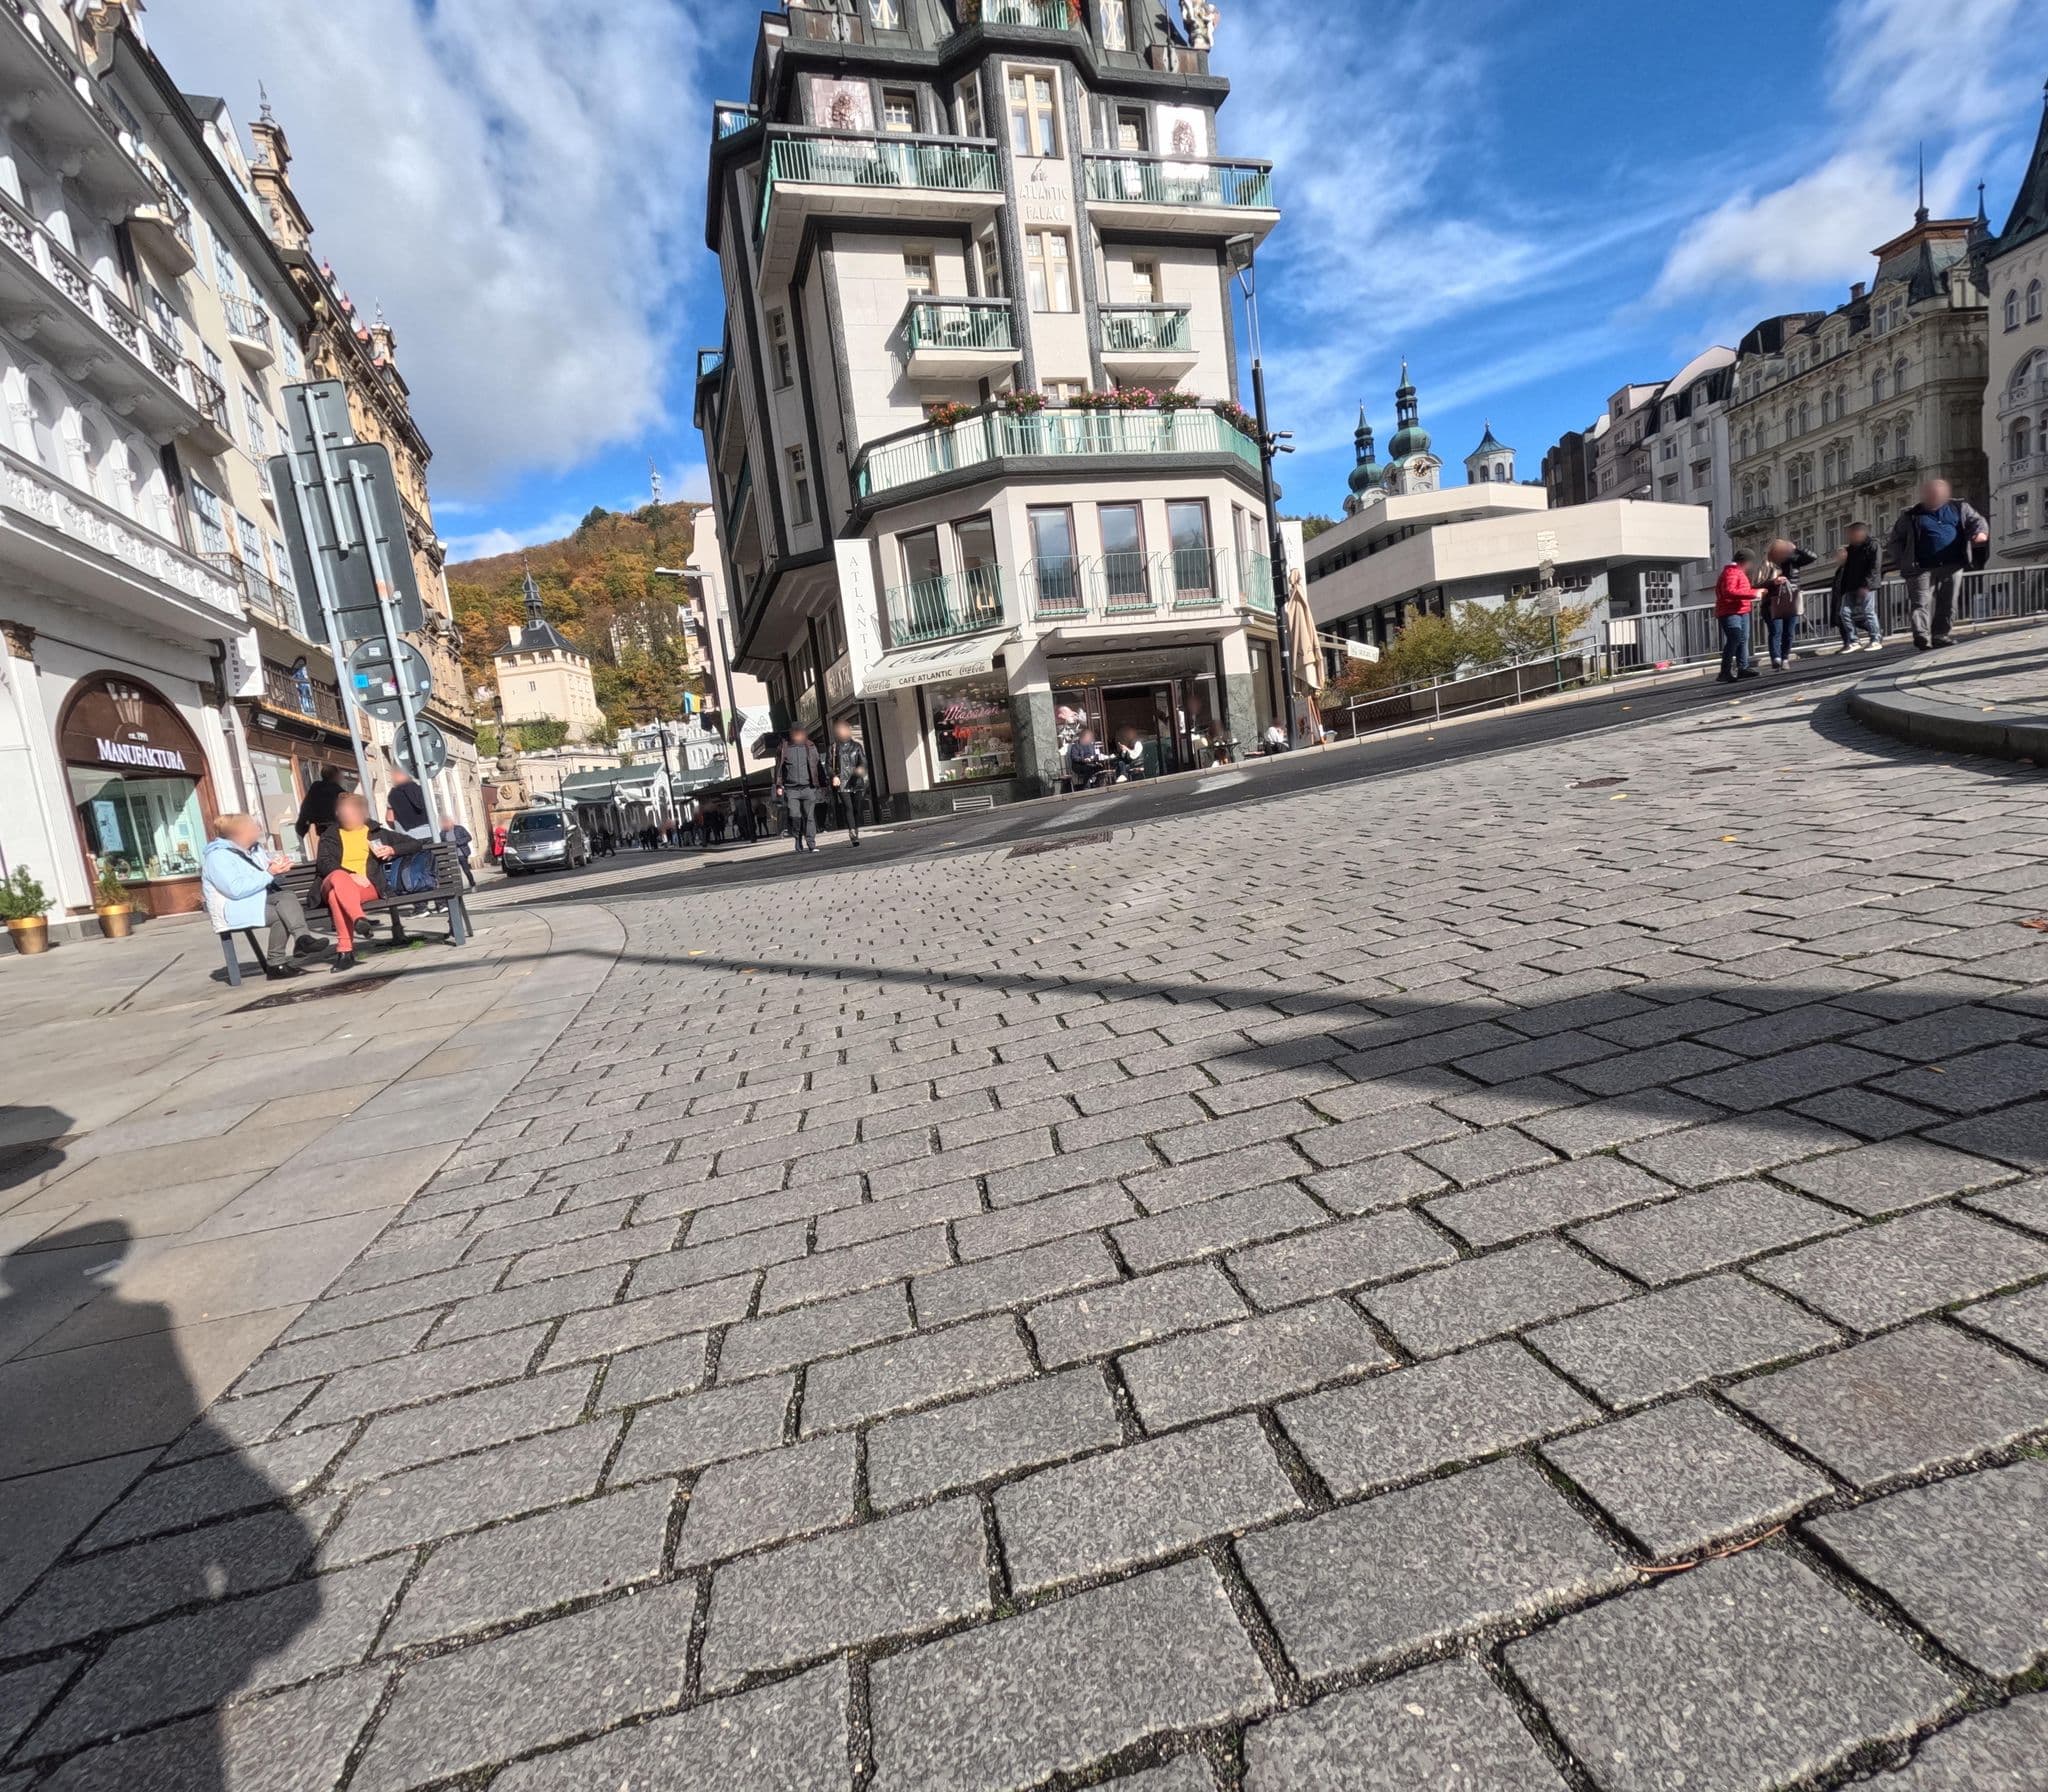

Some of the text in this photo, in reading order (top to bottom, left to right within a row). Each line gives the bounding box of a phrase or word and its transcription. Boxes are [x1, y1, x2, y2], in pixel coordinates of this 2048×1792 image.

[850, 556, 873, 674] ATLANTIC
[898, 669, 952, 685] CAFÉ ATLANTIC
[96, 738, 186, 771] MANUFAKTURA
